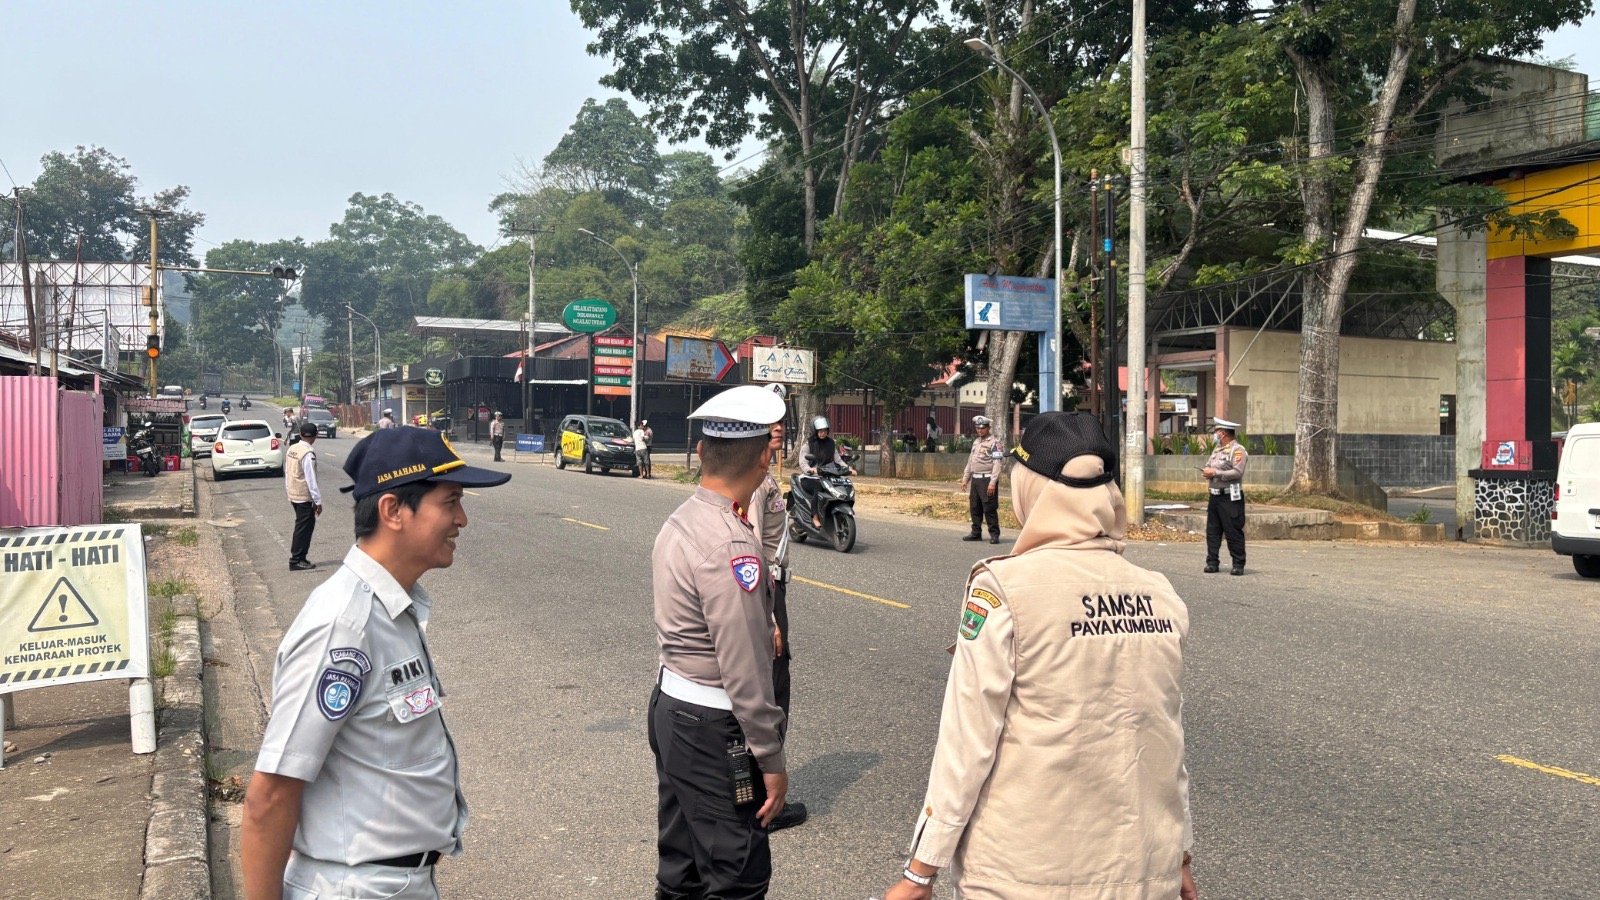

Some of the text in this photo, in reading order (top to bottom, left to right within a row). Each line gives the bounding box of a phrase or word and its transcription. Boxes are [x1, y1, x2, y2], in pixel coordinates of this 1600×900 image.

[377, 464, 426, 484] JASA RAHARJA
[5, 550, 53, 572] HATI
[72, 545, 119, 567] HATI
[1082, 594, 1154, 618] SAMSAT
[1071, 619, 1173, 637] PAYAKUMBUH
[20, 634, 107, 652] KELUAR-MASUK
[5, 644, 122, 665] KENDARAAN PROYEK
[391, 659, 424, 686] RIKI
